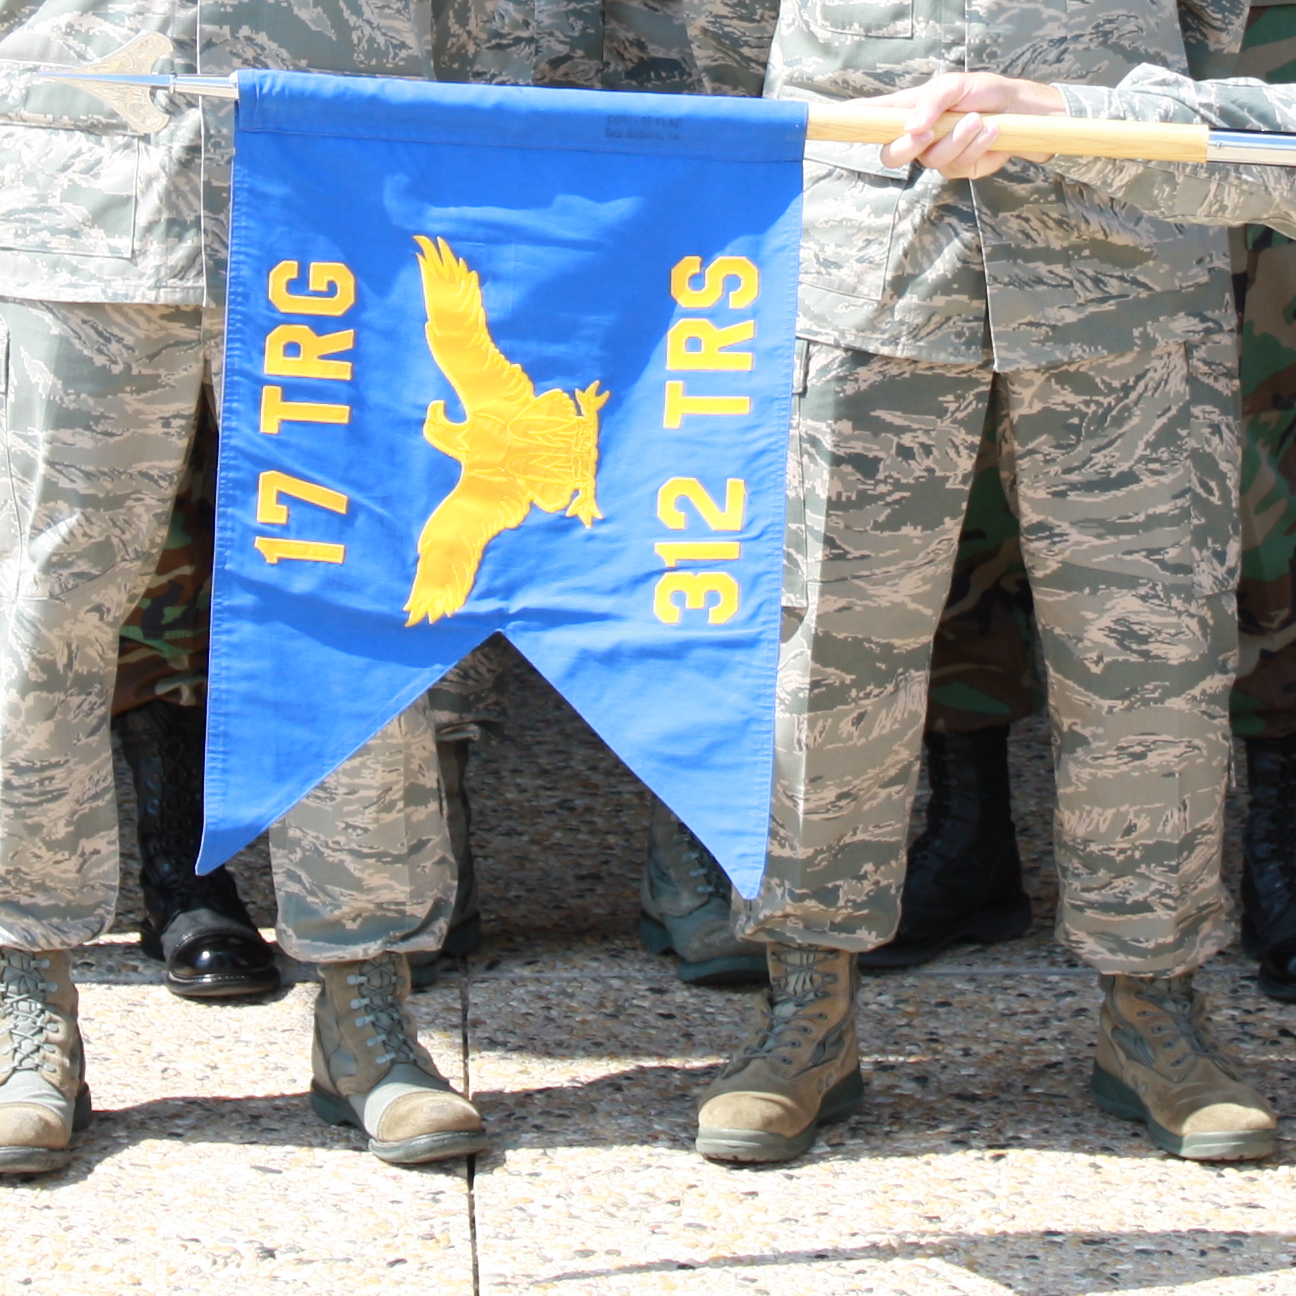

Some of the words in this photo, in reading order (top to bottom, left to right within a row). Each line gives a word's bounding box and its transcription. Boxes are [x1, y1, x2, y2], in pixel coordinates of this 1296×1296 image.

[259, 260, 356, 435] TRG
[663, 255, 760, 430] TRS
[254, 469, 349, 565] 17
[653, 476, 747, 625] 312
